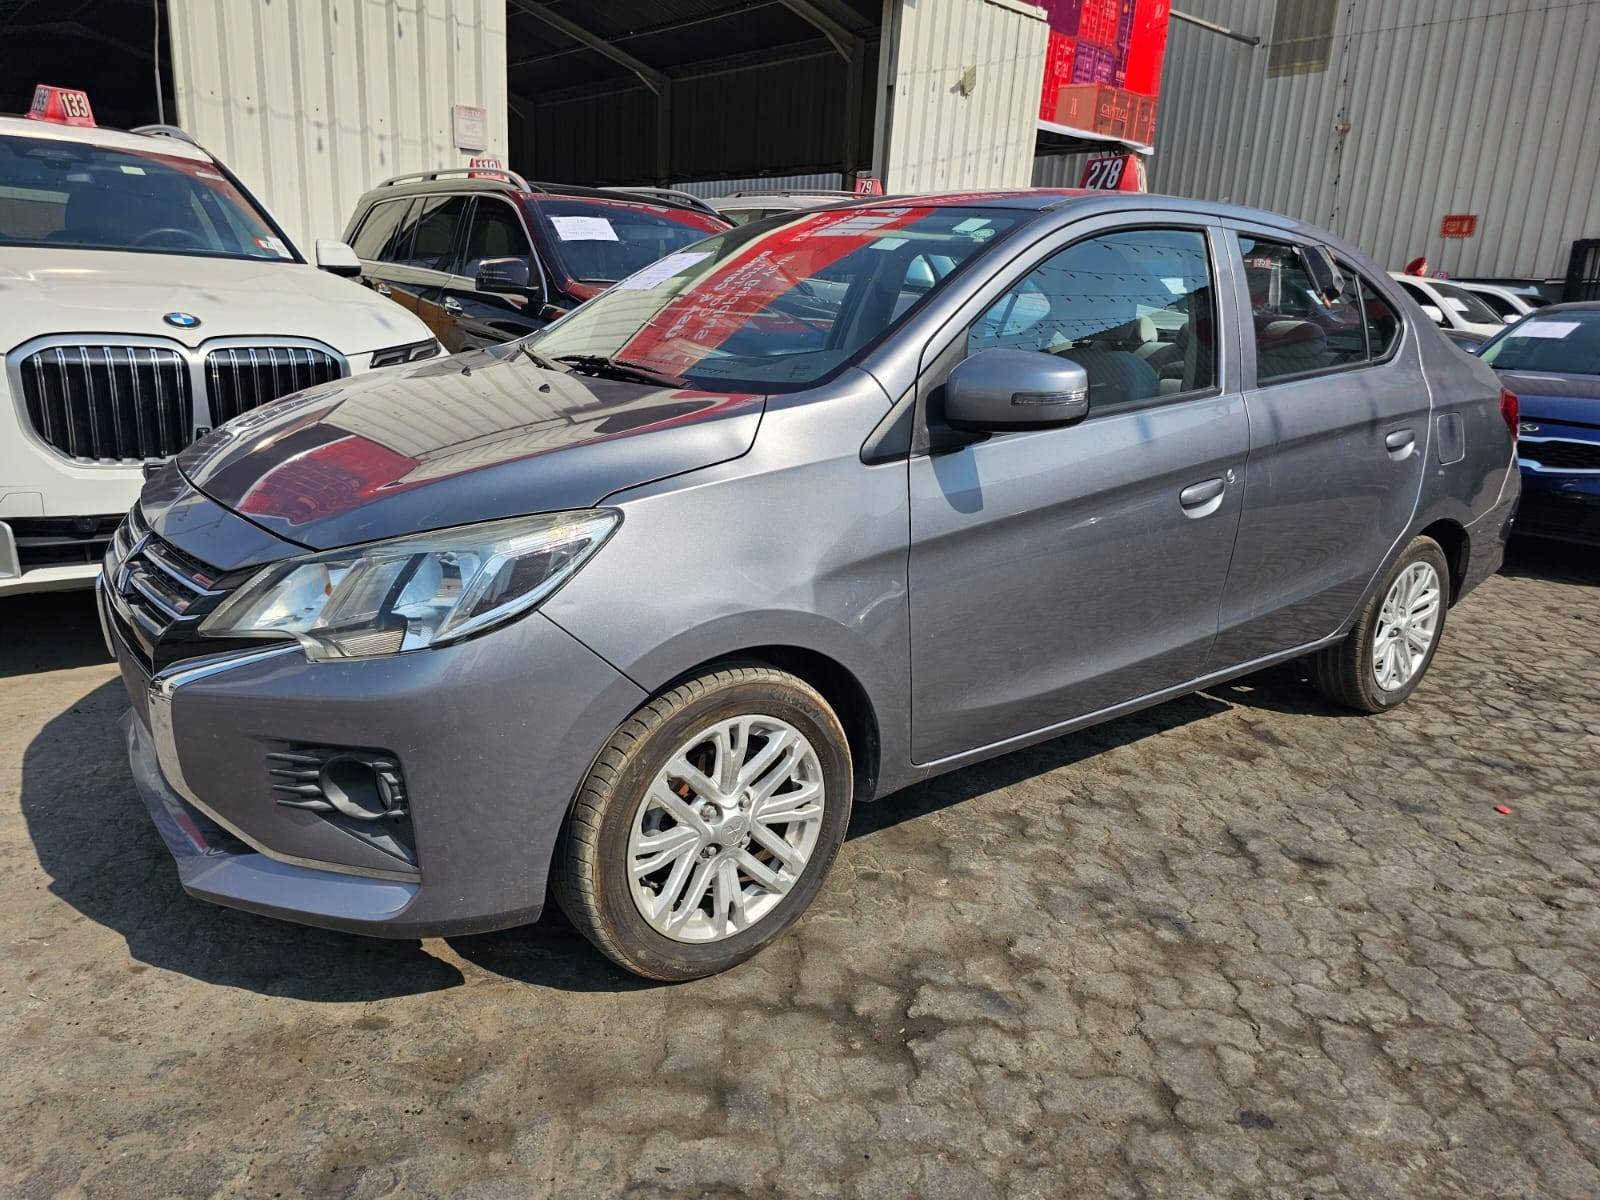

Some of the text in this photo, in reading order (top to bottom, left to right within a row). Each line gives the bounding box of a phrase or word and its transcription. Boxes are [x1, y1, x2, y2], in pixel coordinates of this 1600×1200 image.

[61, 92, 89, 118] 133
[860, 180, 873, 194] 79
[1085, 158, 1124, 191] 278
